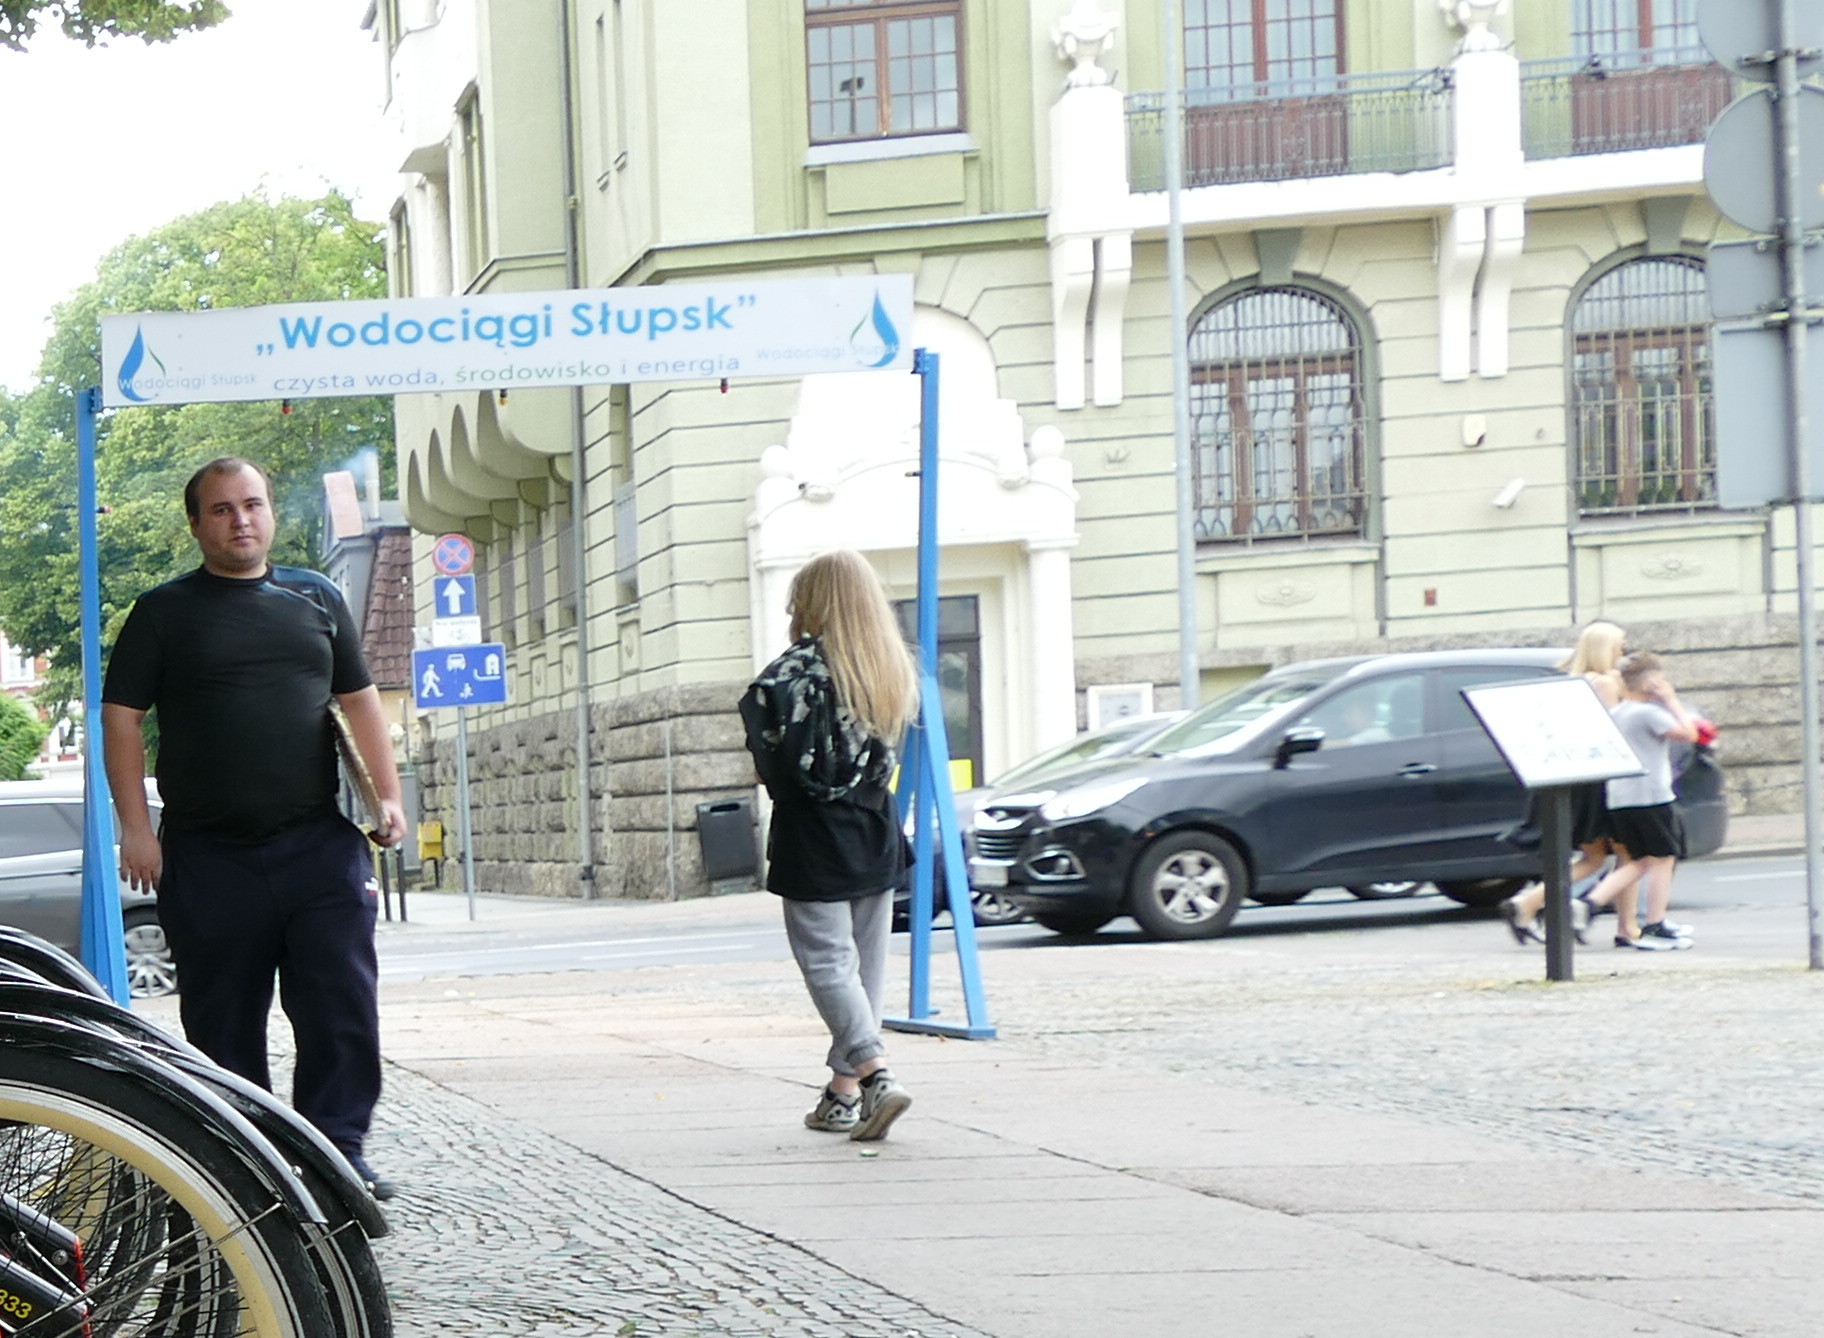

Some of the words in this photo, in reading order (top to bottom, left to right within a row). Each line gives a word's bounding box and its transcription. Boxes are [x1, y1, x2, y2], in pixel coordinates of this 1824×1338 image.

[256, 304, 552, 355] „Wodociągi
[571, 295, 756, 340] Słupsk”
[119, 375, 206, 391] Wodociągi
[211, 373, 258, 386] Słupsk
[274, 374, 355, 394] czysta
[366, 368, 445, 387] woda,
[456, 360, 610, 383] środowisko
[621, 359, 627, 375] i
[638, 355, 740, 377] energia
